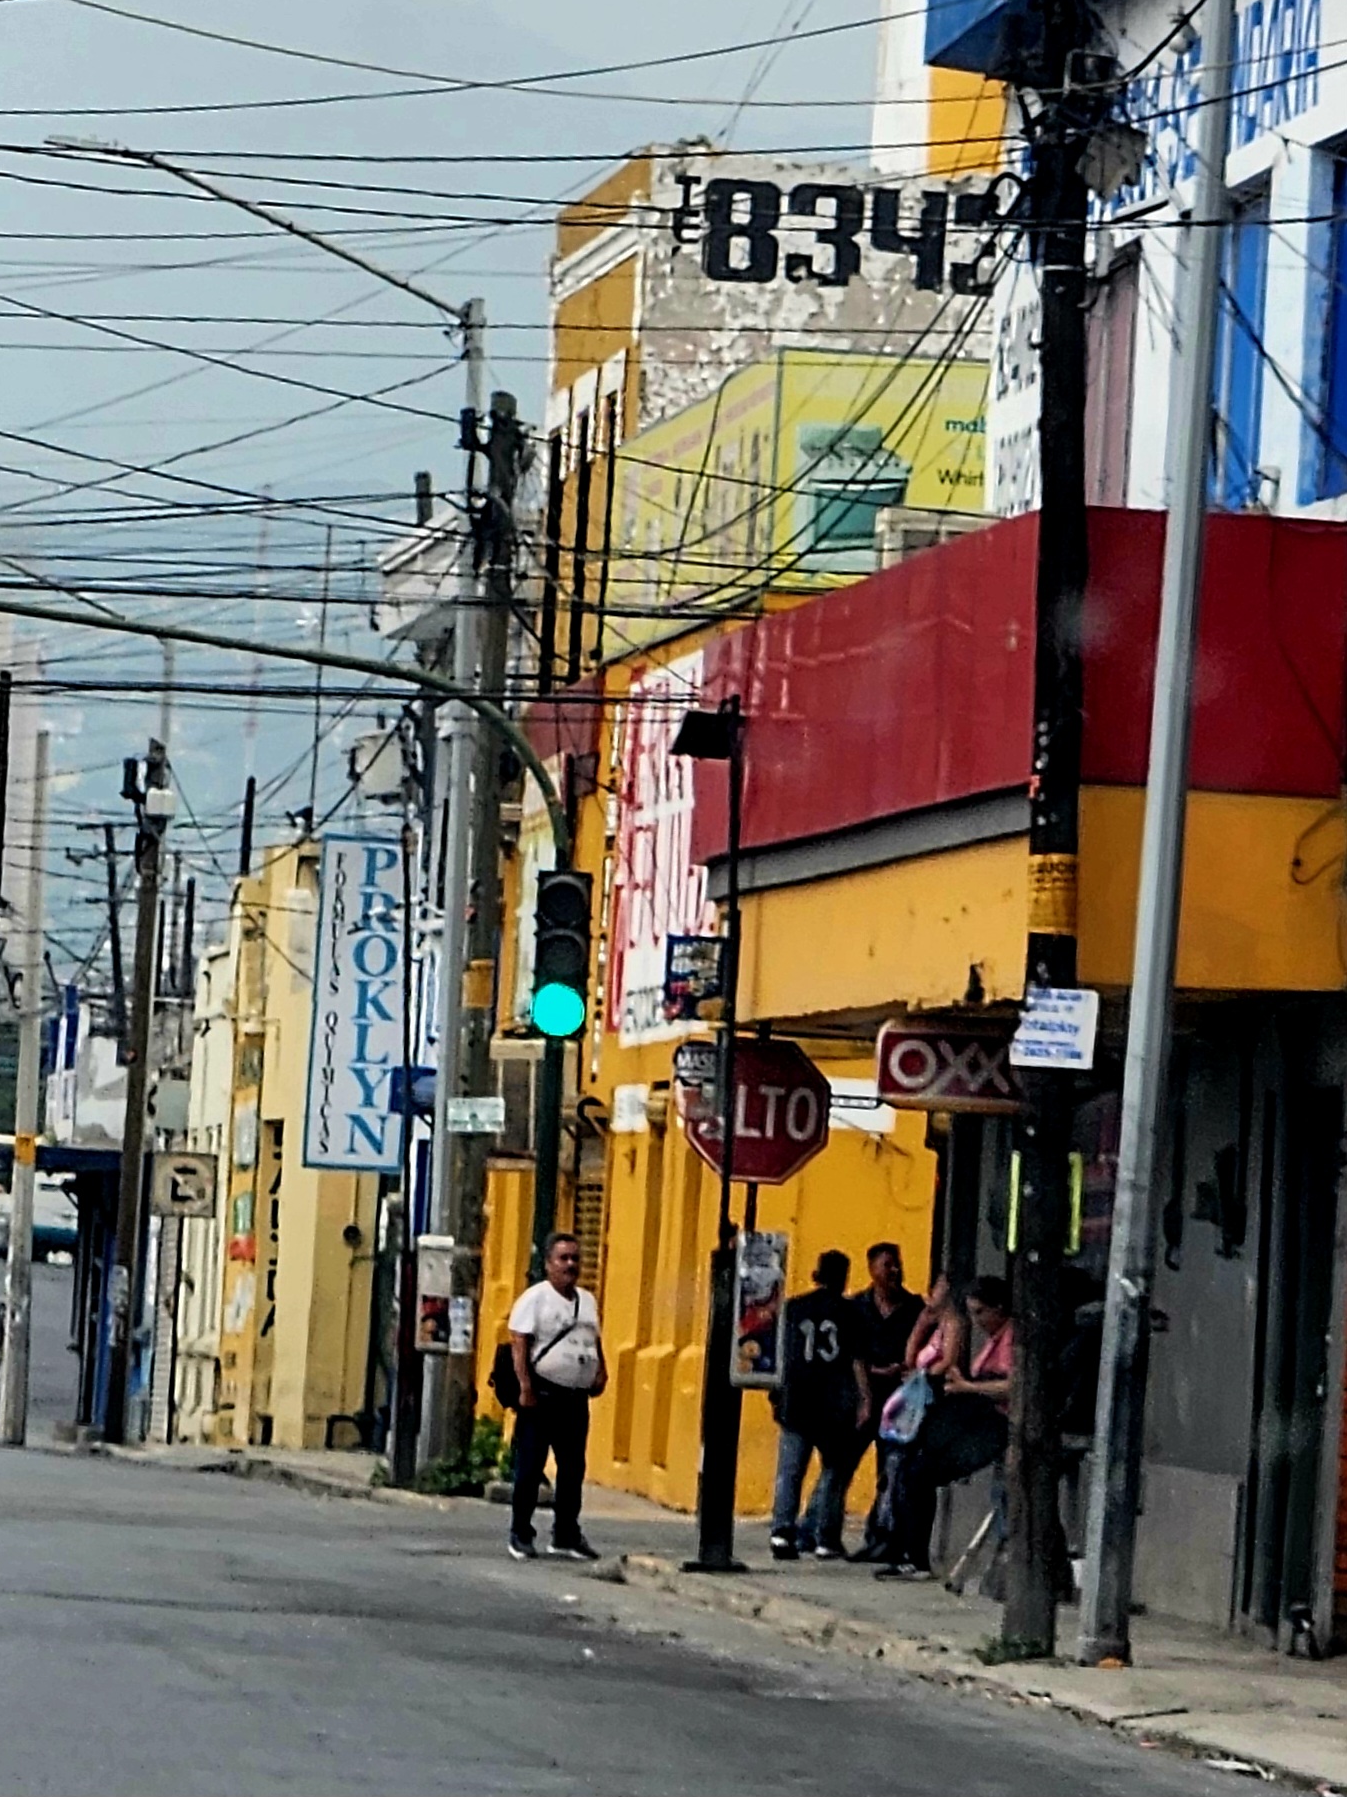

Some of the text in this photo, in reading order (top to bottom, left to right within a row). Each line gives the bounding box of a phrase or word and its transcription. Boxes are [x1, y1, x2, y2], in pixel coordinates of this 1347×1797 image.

[344, 846, 400, 1156] PROKLYN
[888, 1038, 1023, 1098] OXX
[799, 1318, 840, 1362] 13
